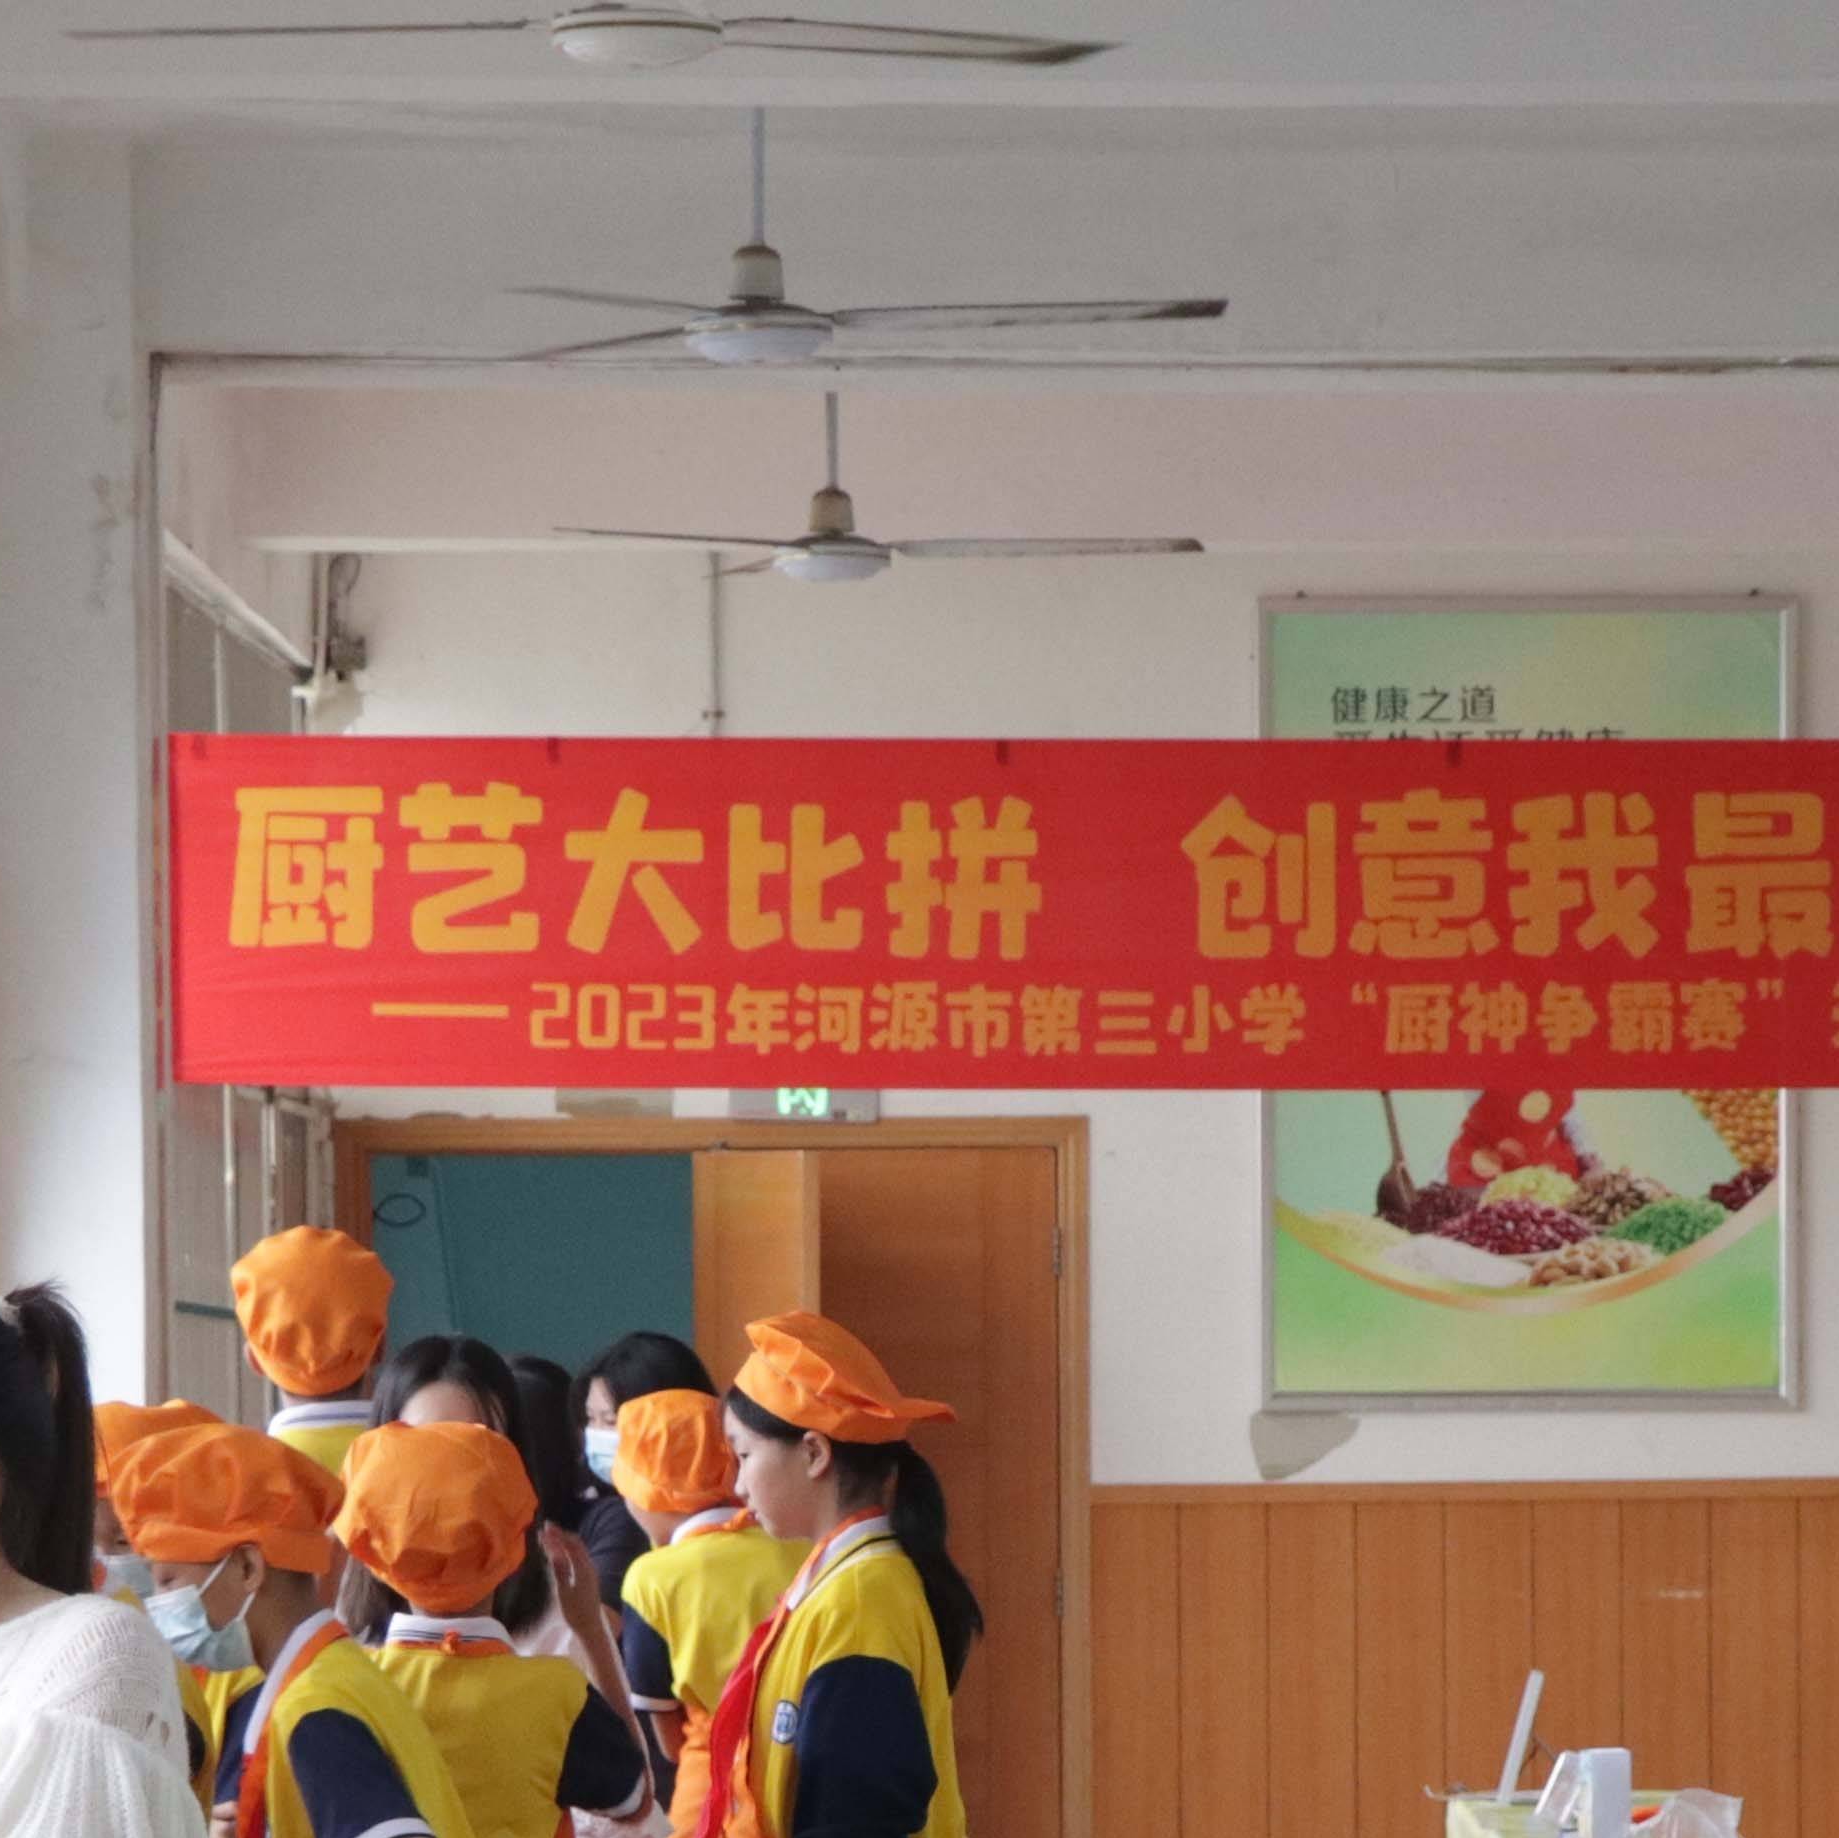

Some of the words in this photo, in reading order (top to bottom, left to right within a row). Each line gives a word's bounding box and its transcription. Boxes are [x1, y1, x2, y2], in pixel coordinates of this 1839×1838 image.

[1331, 685, 1497, 725] 健康之道
[228, 781, 1042, 960] 厨艺大比拼
